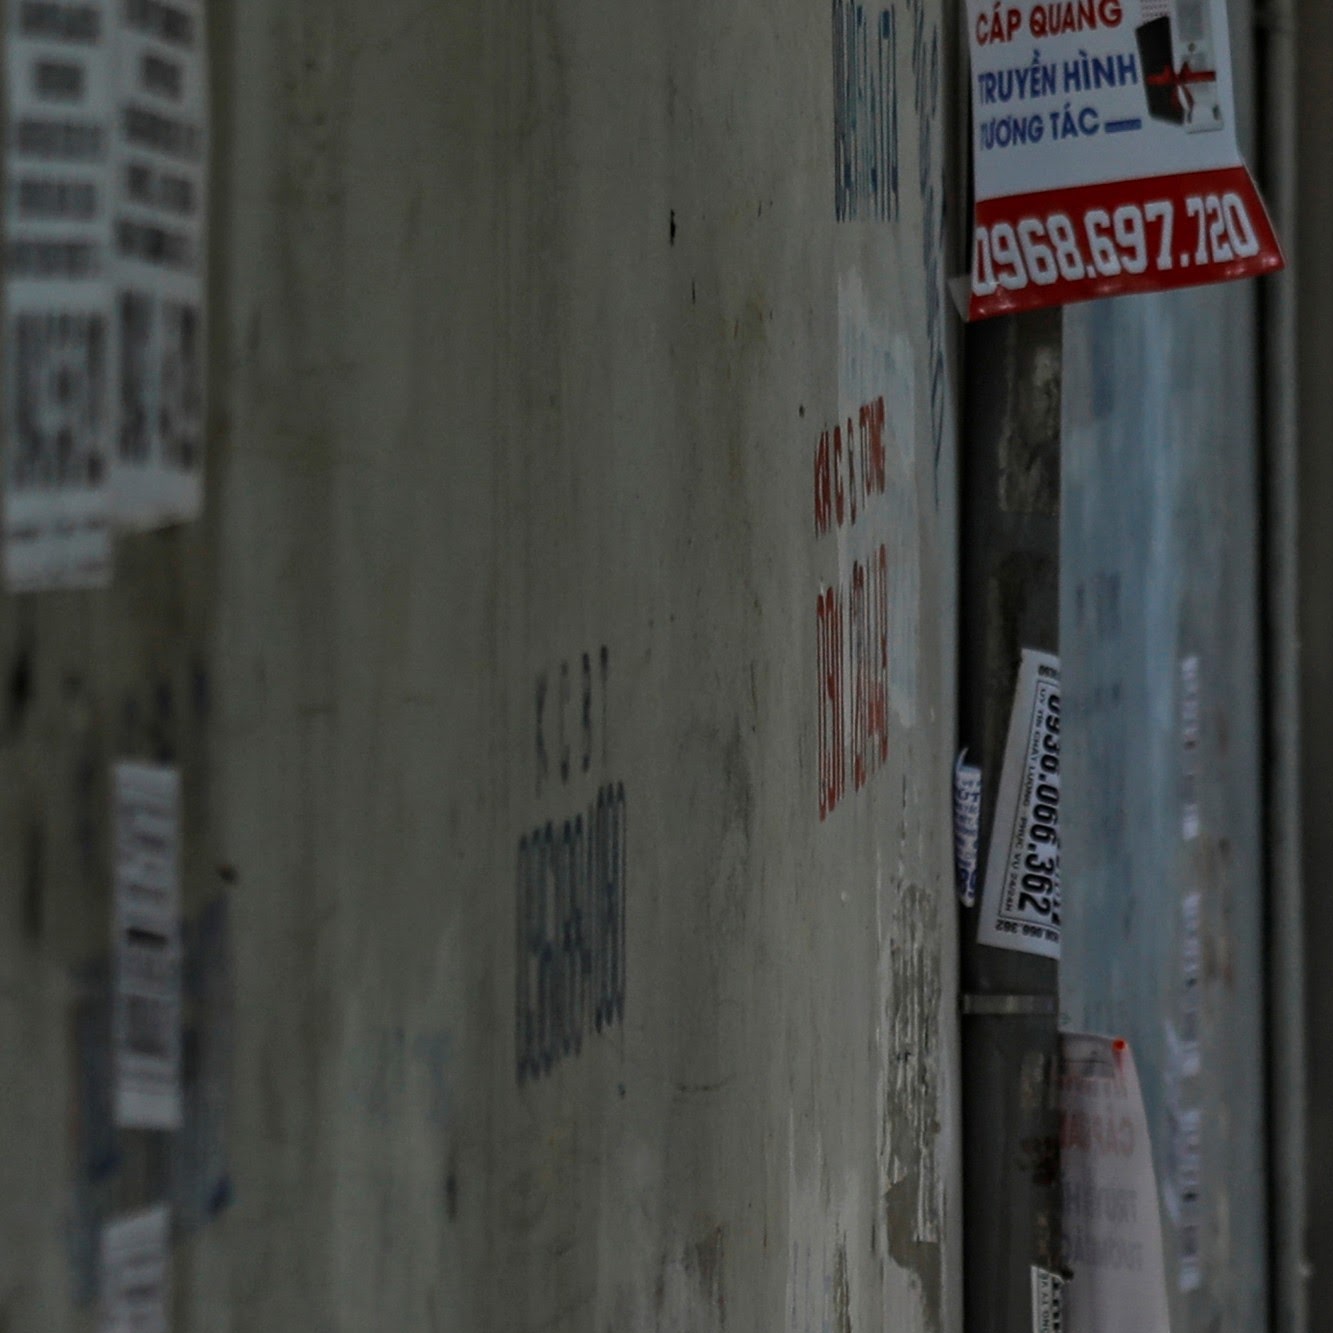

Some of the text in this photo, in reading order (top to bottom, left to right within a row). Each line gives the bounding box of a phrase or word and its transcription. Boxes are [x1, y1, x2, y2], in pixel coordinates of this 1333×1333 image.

[975, 1, 1022, 46] CÁP
[1029, 0, 1123, 39] QUANG
[977, 50, 1139, 105] TRUYỀN HÌNH
[1050, 107, 1100, 139] TÁC
[972, 193, 1260, 296] 0968.697.720
